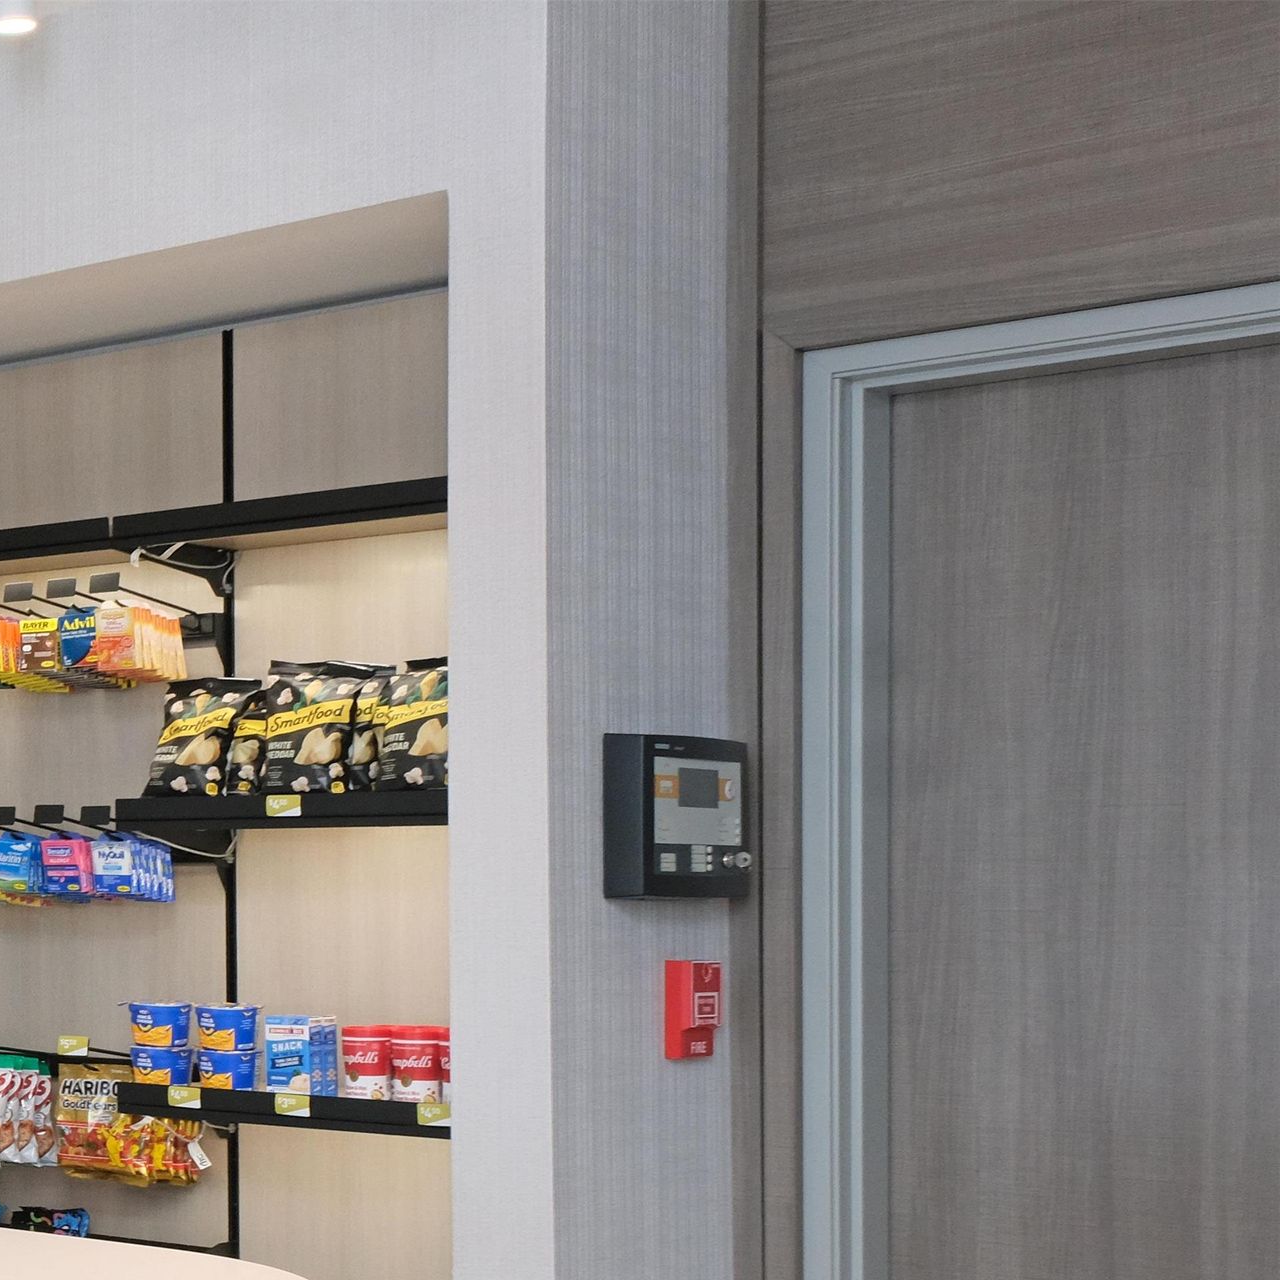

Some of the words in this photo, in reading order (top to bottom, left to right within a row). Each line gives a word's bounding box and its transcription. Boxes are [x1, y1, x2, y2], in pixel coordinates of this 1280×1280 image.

[22, 621, 49, 630] BAYER
[61, 617, 96, 632] Advil
[269, 704, 345, 731] Smartfood
[97, 849, 125, 862] NyQuil
[271, 1042, 303, 1053] SNACK
[690, 1040, 707, 1055] FIRE
[62, 1099, 117, 1111] Goldbears
